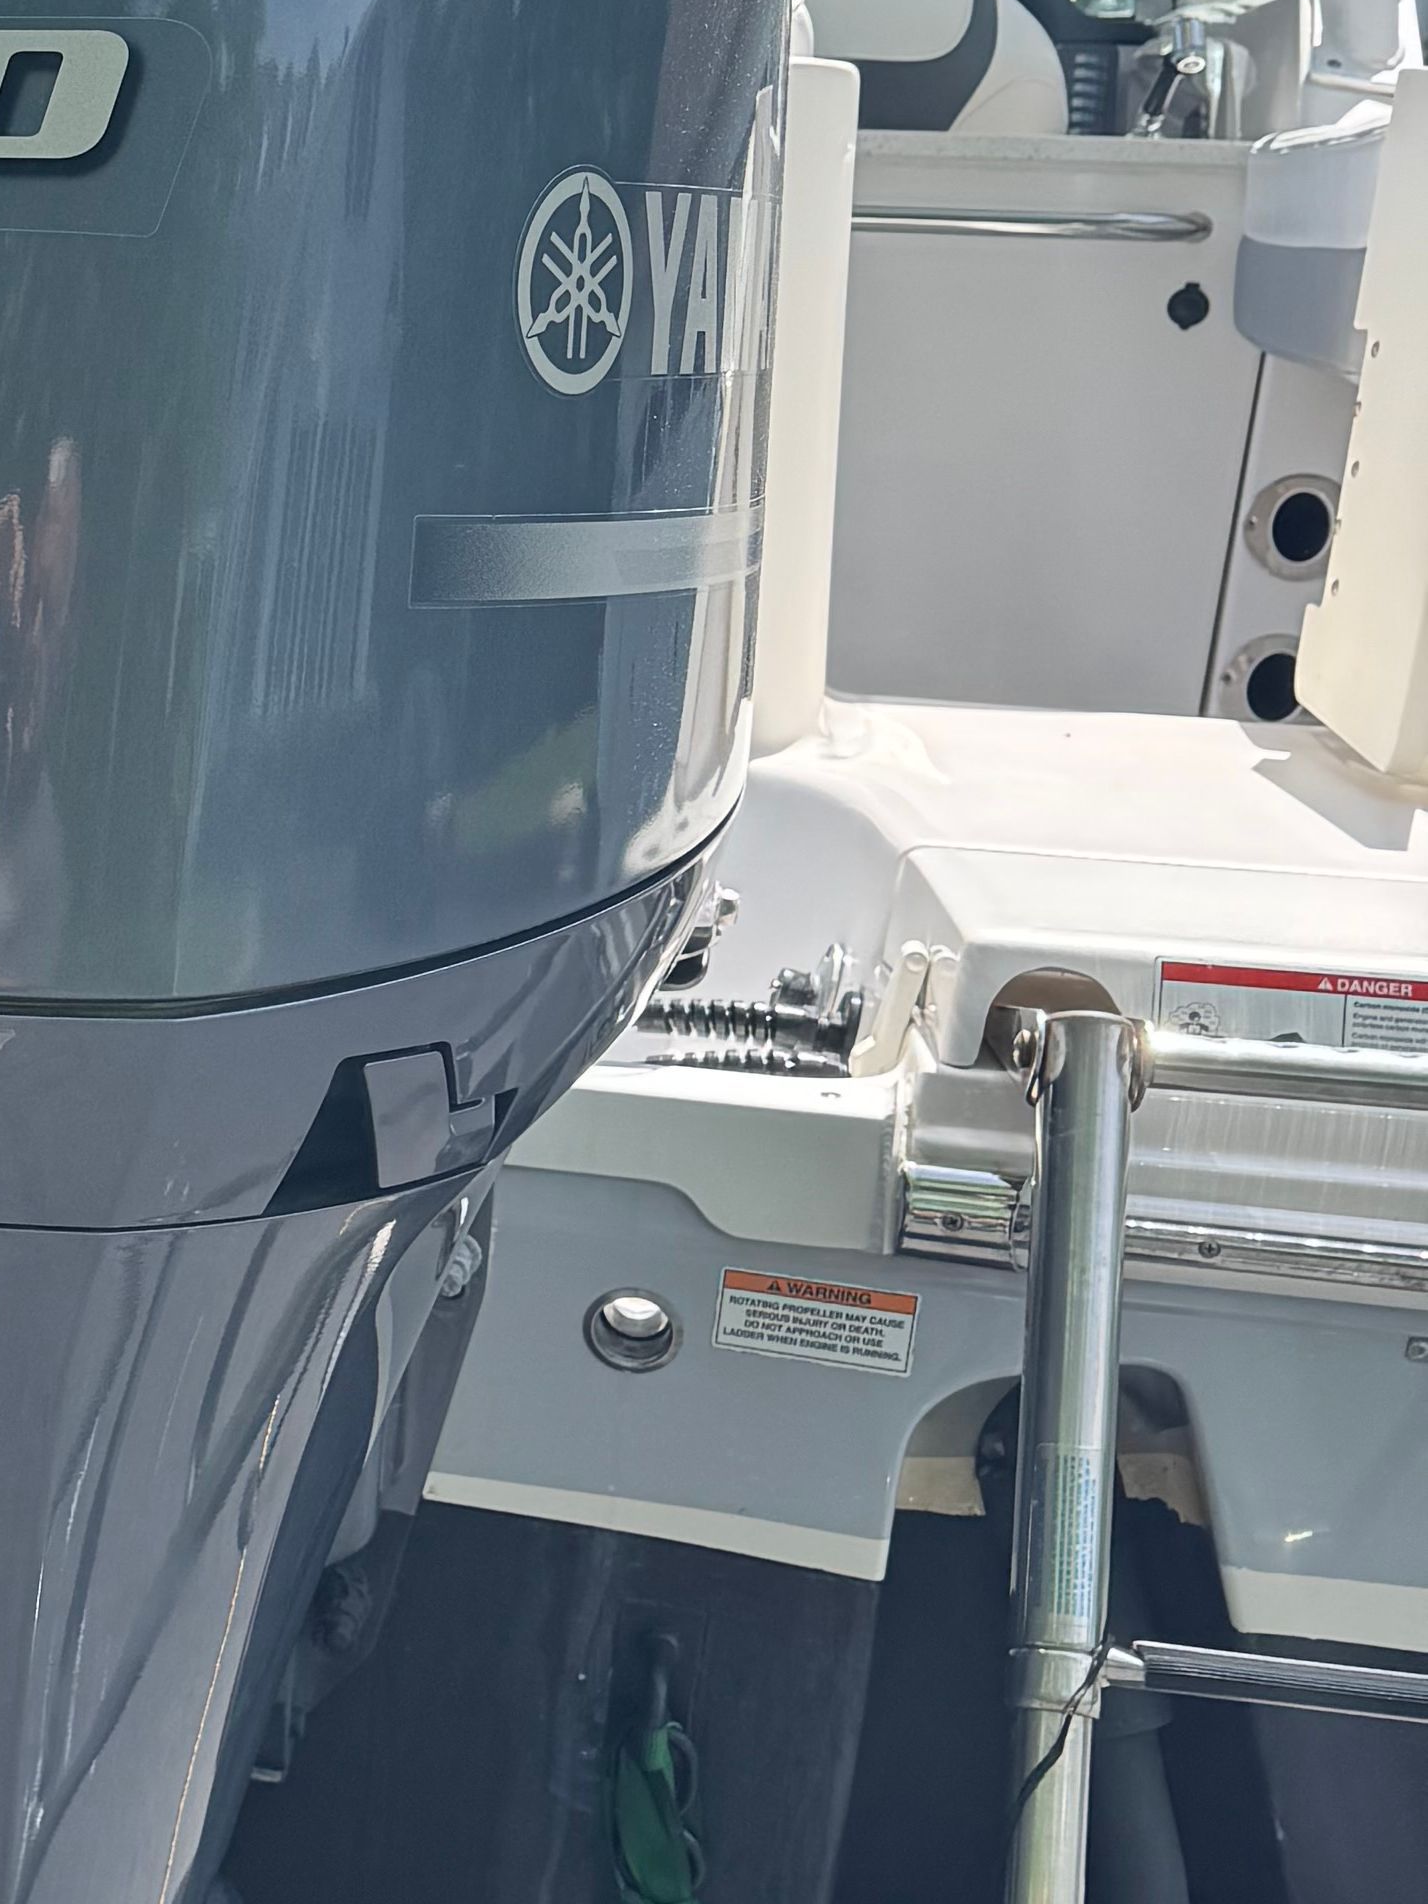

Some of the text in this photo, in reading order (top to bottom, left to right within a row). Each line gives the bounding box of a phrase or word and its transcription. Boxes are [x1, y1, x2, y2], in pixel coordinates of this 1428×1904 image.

[645, 191, 779, 376] YAMA
[1337, 978, 1413, 997] DANGER
[787, 1281, 872, 1305] WARNING
[745, 1308, 791, 1324] SERIOUS
[830, 1321, 846, 1332] OR
[781, 1303, 843, 1320] PROPELLER
[845, 1312, 867, 1323] MAY
[869, 1316, 905, 1330] CAUSE
[723, 1326, 765, 1342] LADDER
[766, 1333, 798, 1347] WHEN
[840, 1344, 851, 1355] IS
[744, 1319, 884, 1349] DO NOT APPROACH OR USE
